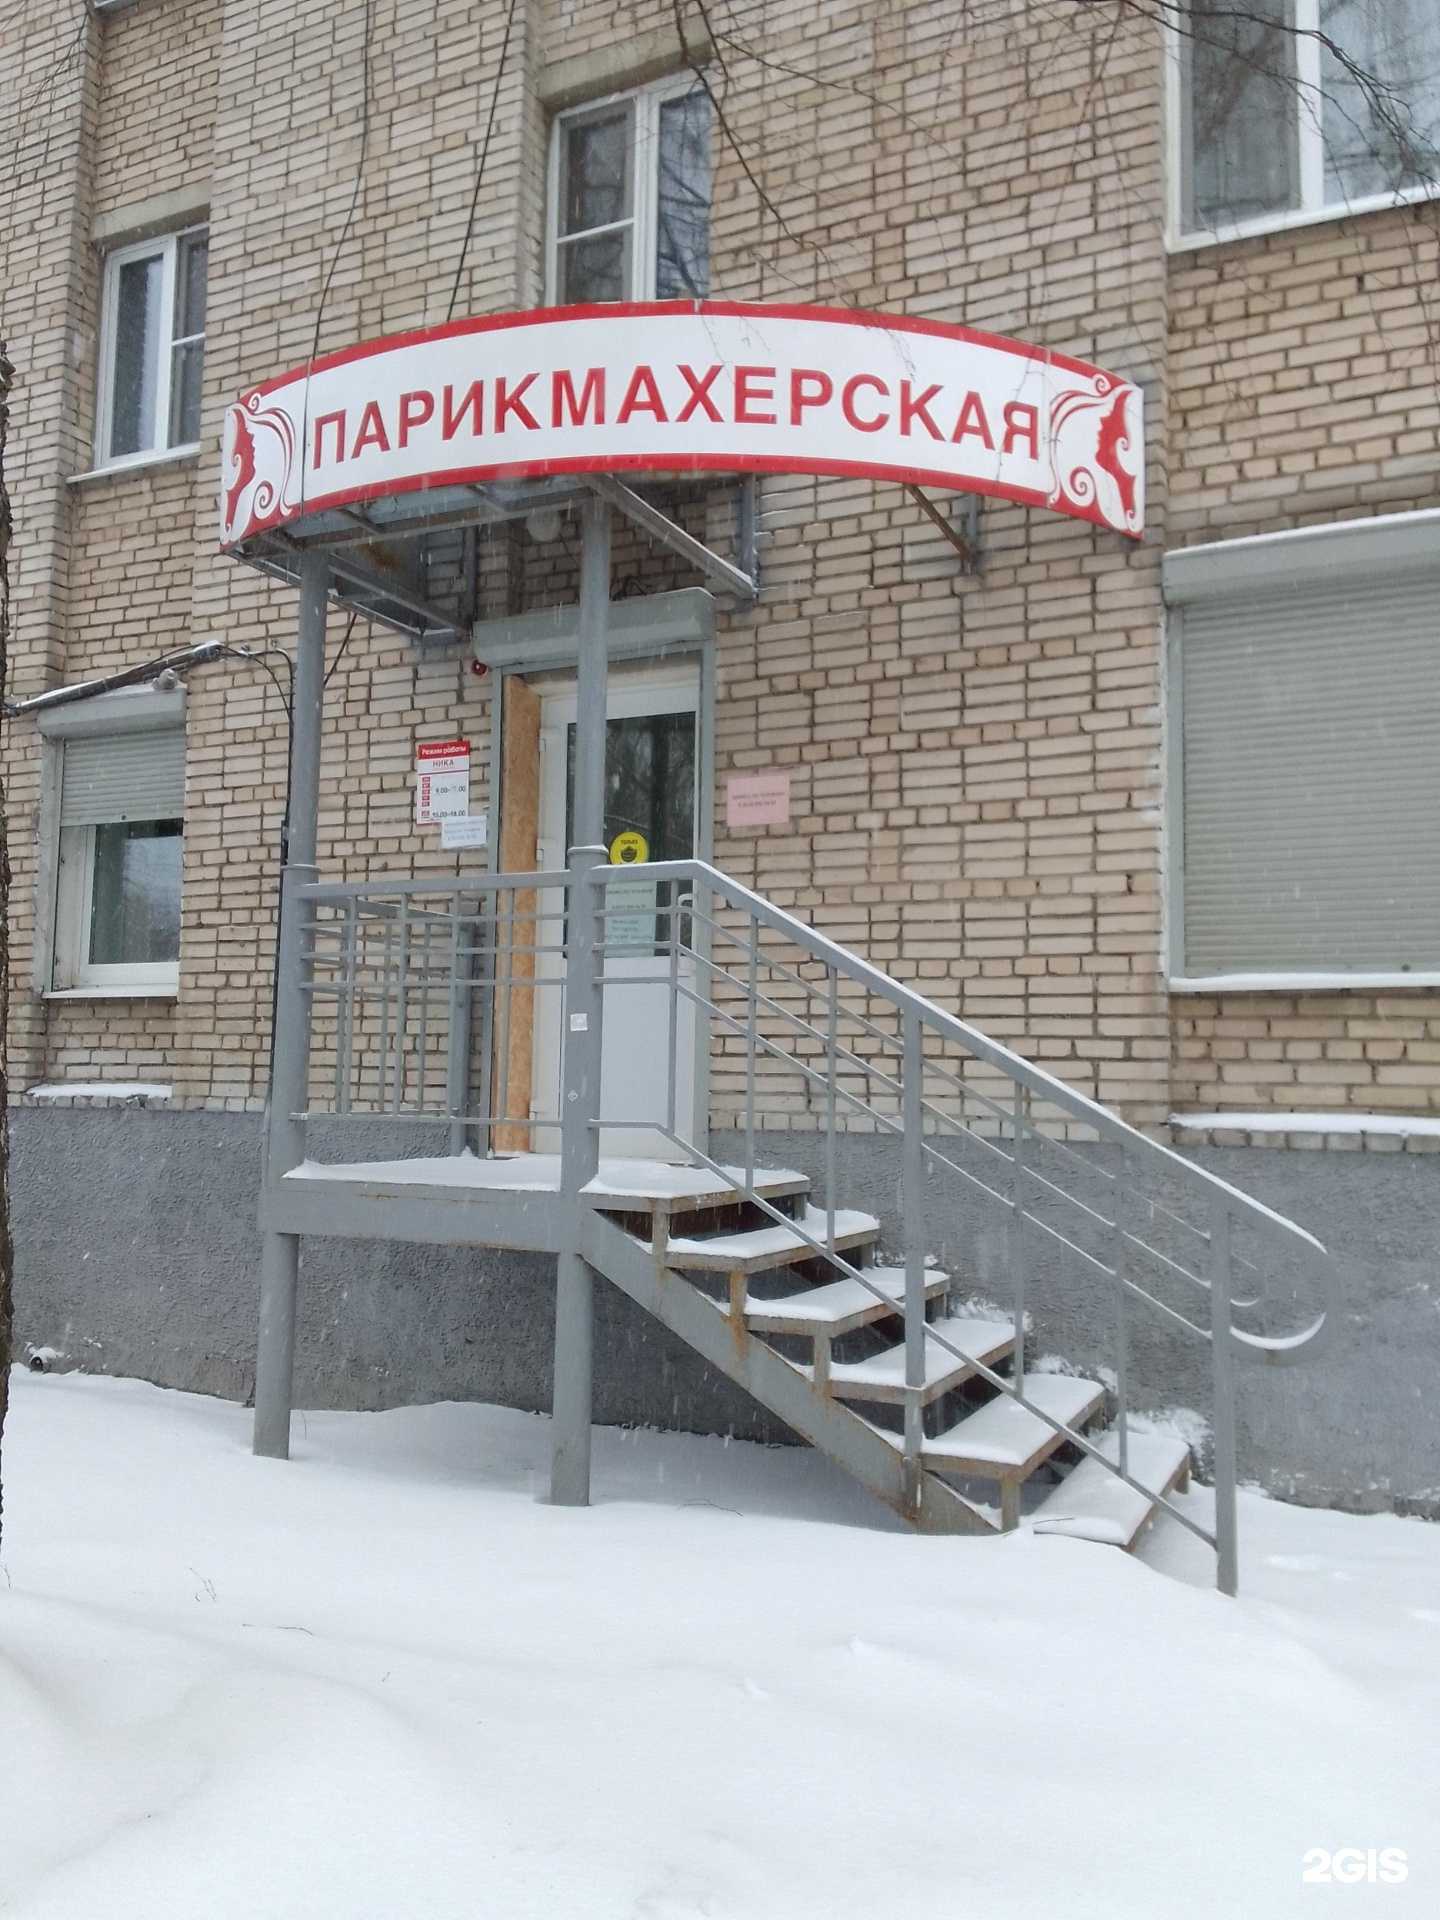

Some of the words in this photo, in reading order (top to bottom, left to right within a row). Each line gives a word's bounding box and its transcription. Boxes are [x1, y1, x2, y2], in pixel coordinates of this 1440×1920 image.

[311, 363, 1040, 469] ПАРИКМАХЕРСКАЯ
[443, 746, 466, 755] работы
[432, 759, 454, 768] НИКА
